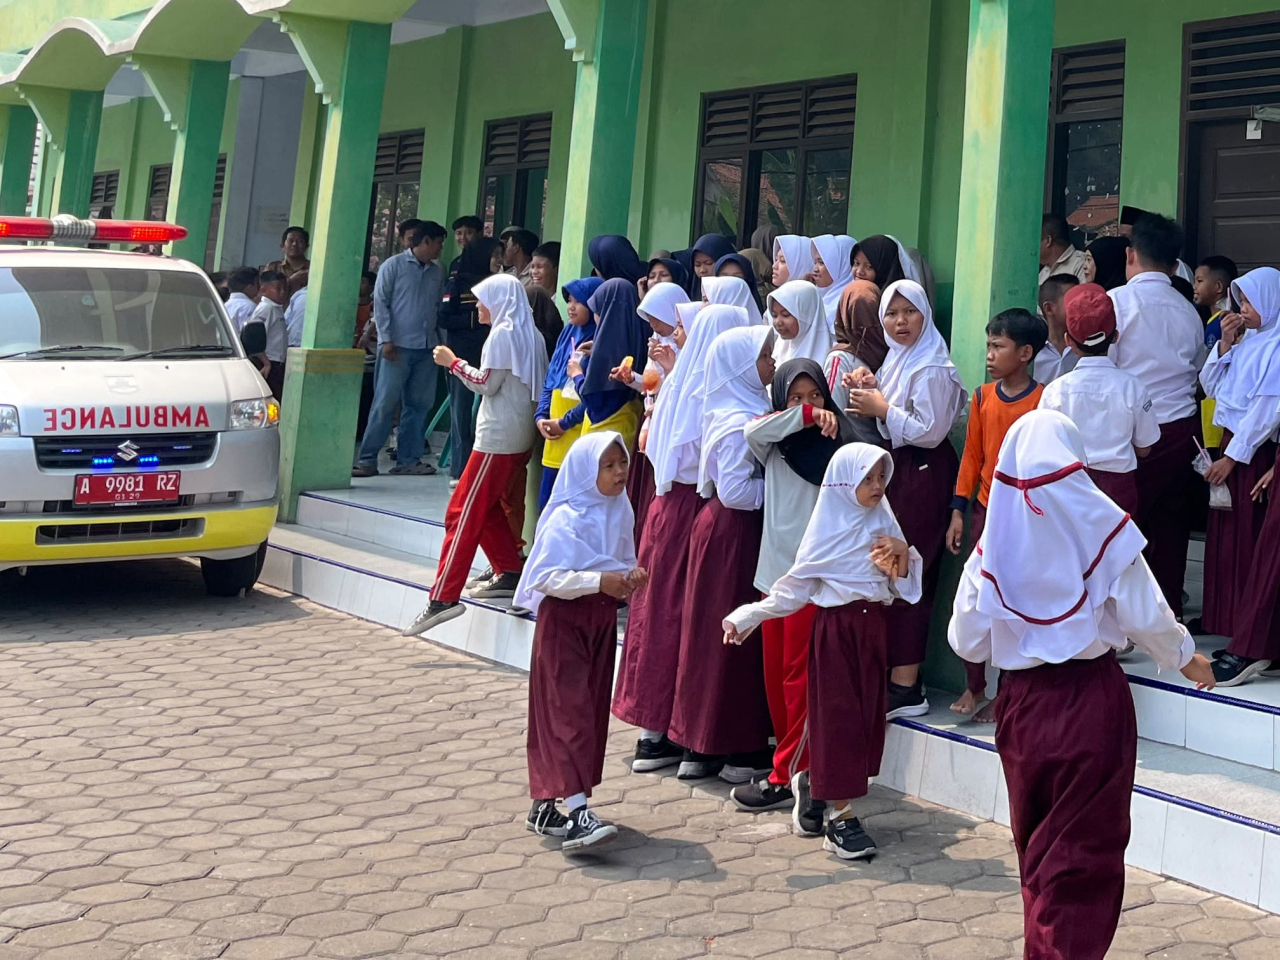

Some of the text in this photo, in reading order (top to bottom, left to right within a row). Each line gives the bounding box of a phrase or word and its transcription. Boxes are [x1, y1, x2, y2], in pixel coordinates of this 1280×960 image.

[80, 474, 177, 494] A 9981 RZ
